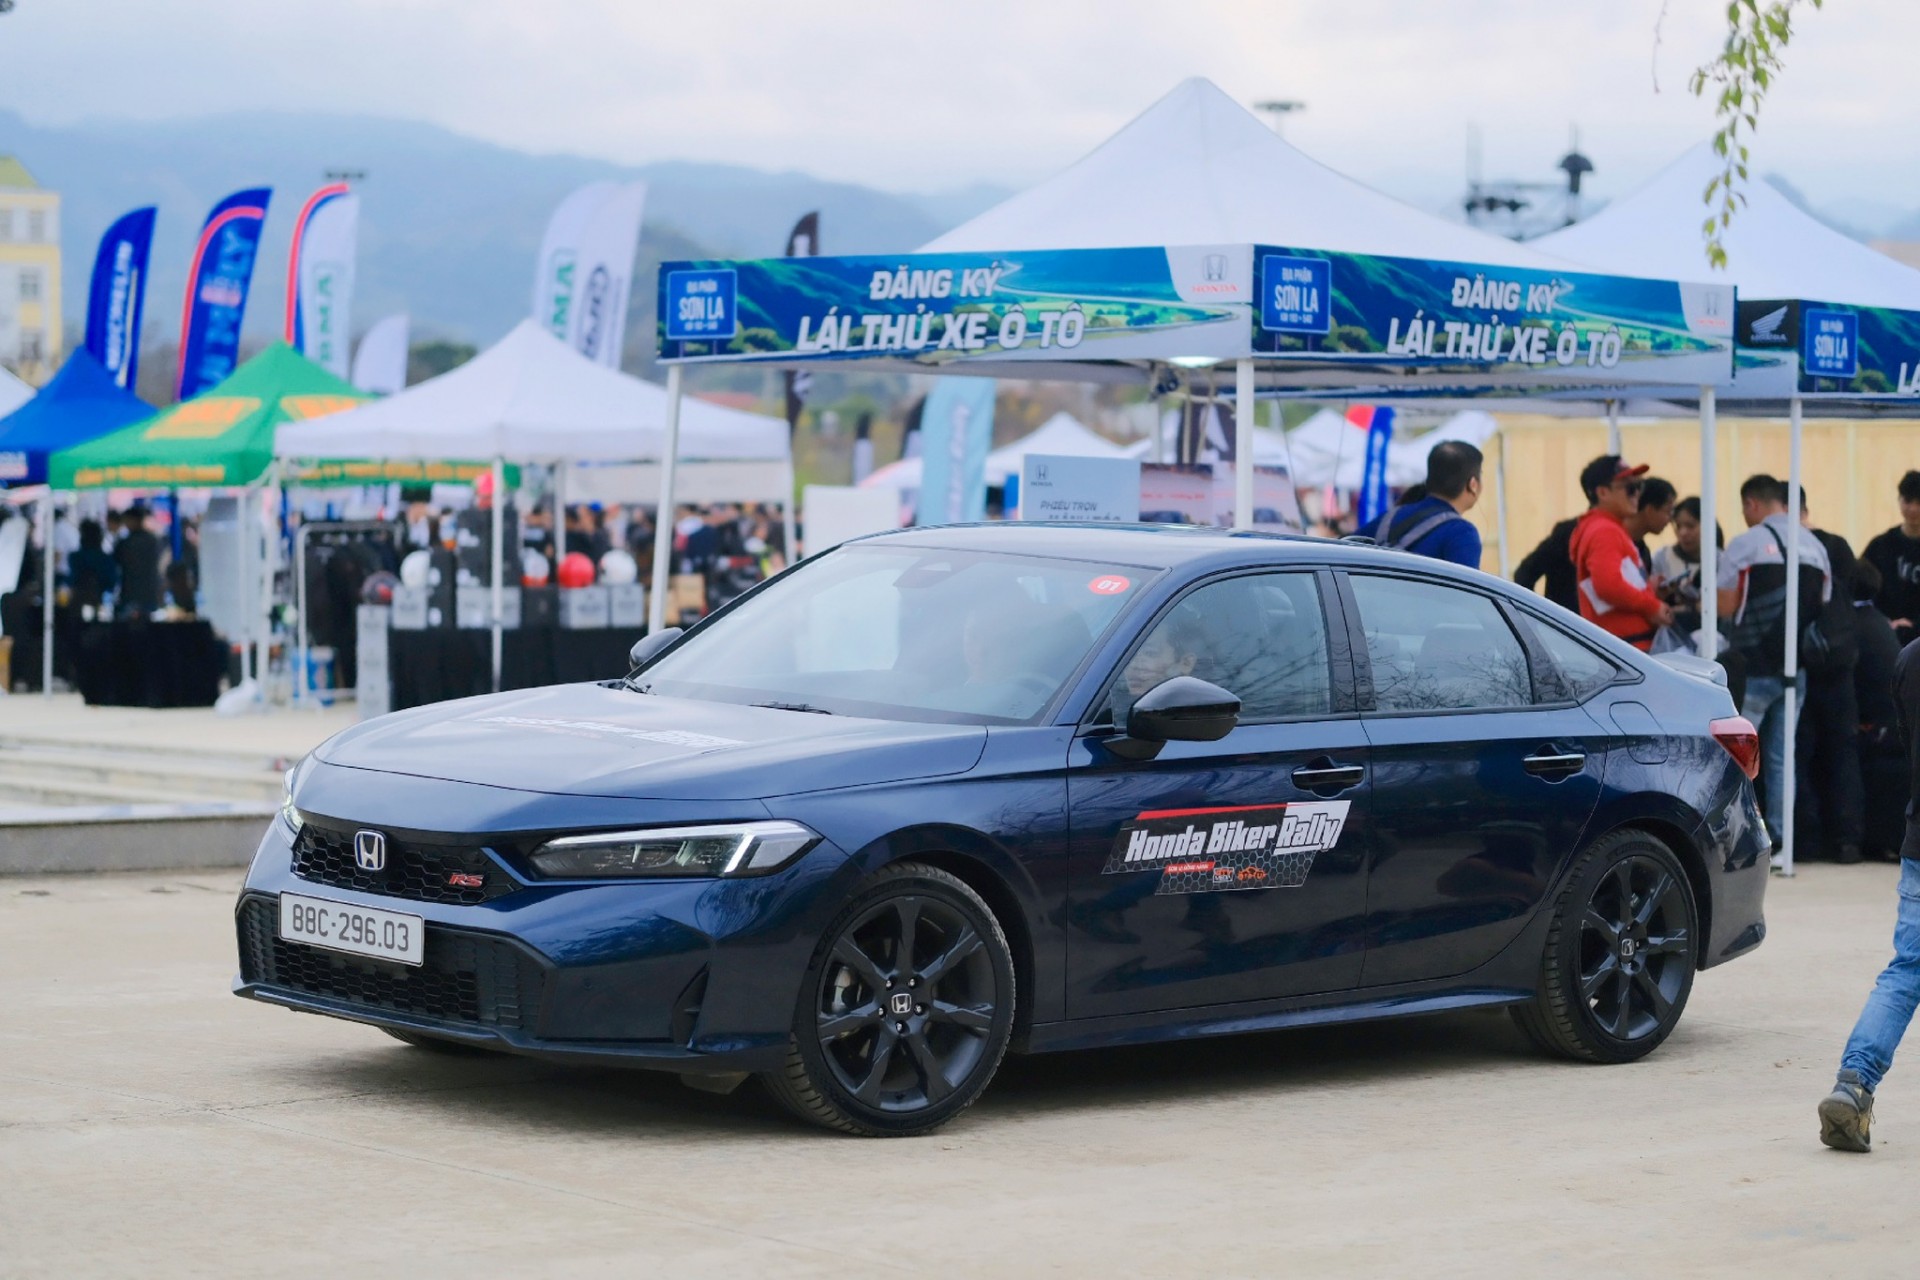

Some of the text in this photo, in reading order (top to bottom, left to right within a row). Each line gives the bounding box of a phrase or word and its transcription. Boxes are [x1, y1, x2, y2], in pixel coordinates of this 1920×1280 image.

[870, 261, 1003, 300] ĐĂNG KÝ
[1191, 284, 1239, 293] HONDA
[1274, 284, 1319, 313] SƠN LA
[1452, 273, 1560, 313] ĐĂNG KÝ
[679, 295, 725, 321] SƠN LA
[797, 301, 1085, 351] LÁI THỬ XE Ô TÔ
[1386, 309, 1622, 368] LÁI THỬ XE Ô TÔ
[1835, 336, 1848, 360] LA
[1124, 813, 1341, 863] Honda Biker Rally
[449, 873, 484, 887] RS
[291, 903, 410, 952] 88C-296.03
